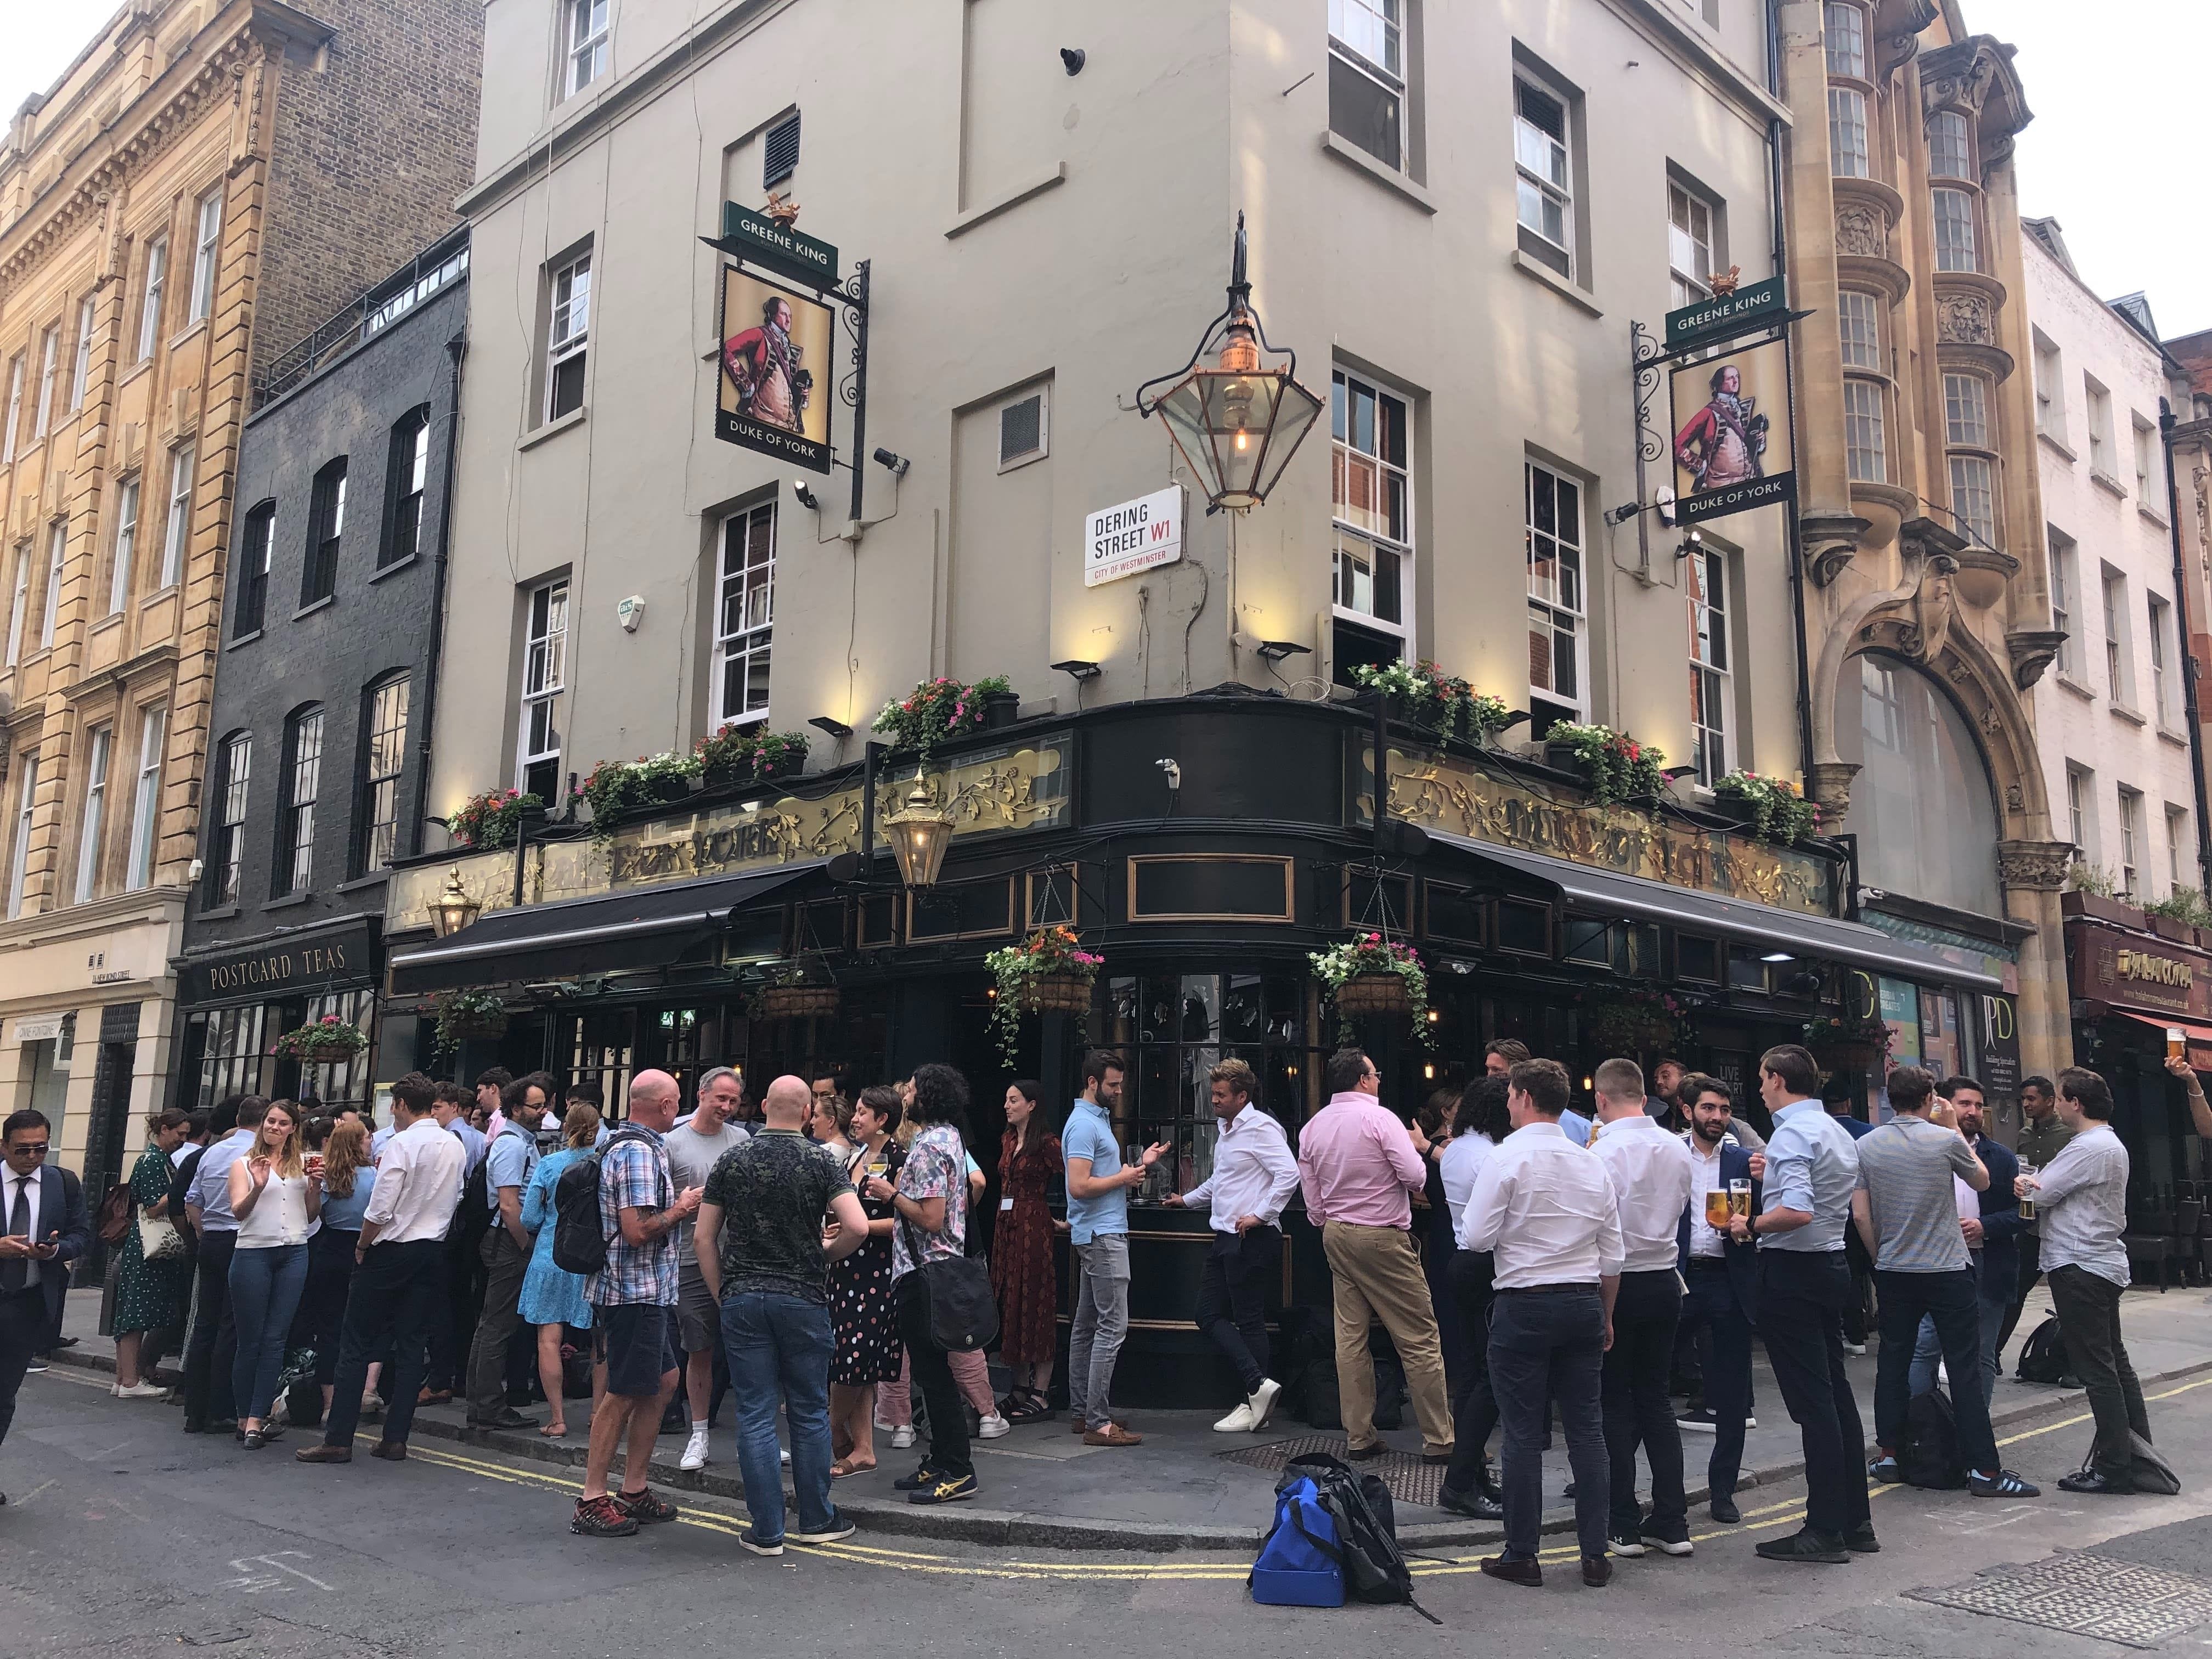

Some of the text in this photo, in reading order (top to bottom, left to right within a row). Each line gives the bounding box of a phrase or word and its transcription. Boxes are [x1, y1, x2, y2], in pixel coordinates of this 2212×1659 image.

[741, 219, 827, 265] GREENE KING
[1678, 291, 1771, 330] GREENE KING
[730, 420, 816, 459] DUKE OF YORK
[1690, 481, 1782, 512] DUKE OF YORK
[1095, 520, 1170, 559] STREET W1
[1096, 504, 1148, 537] DERING
[1094, 550, 1166, 579] CITY OF WESTMINSTER
[211, 945, 345, 990] POSTCARD TEAS
[1982, 995, 2013, 1050] JPD
[1720, 1065, 1739, 1081] LIVE
